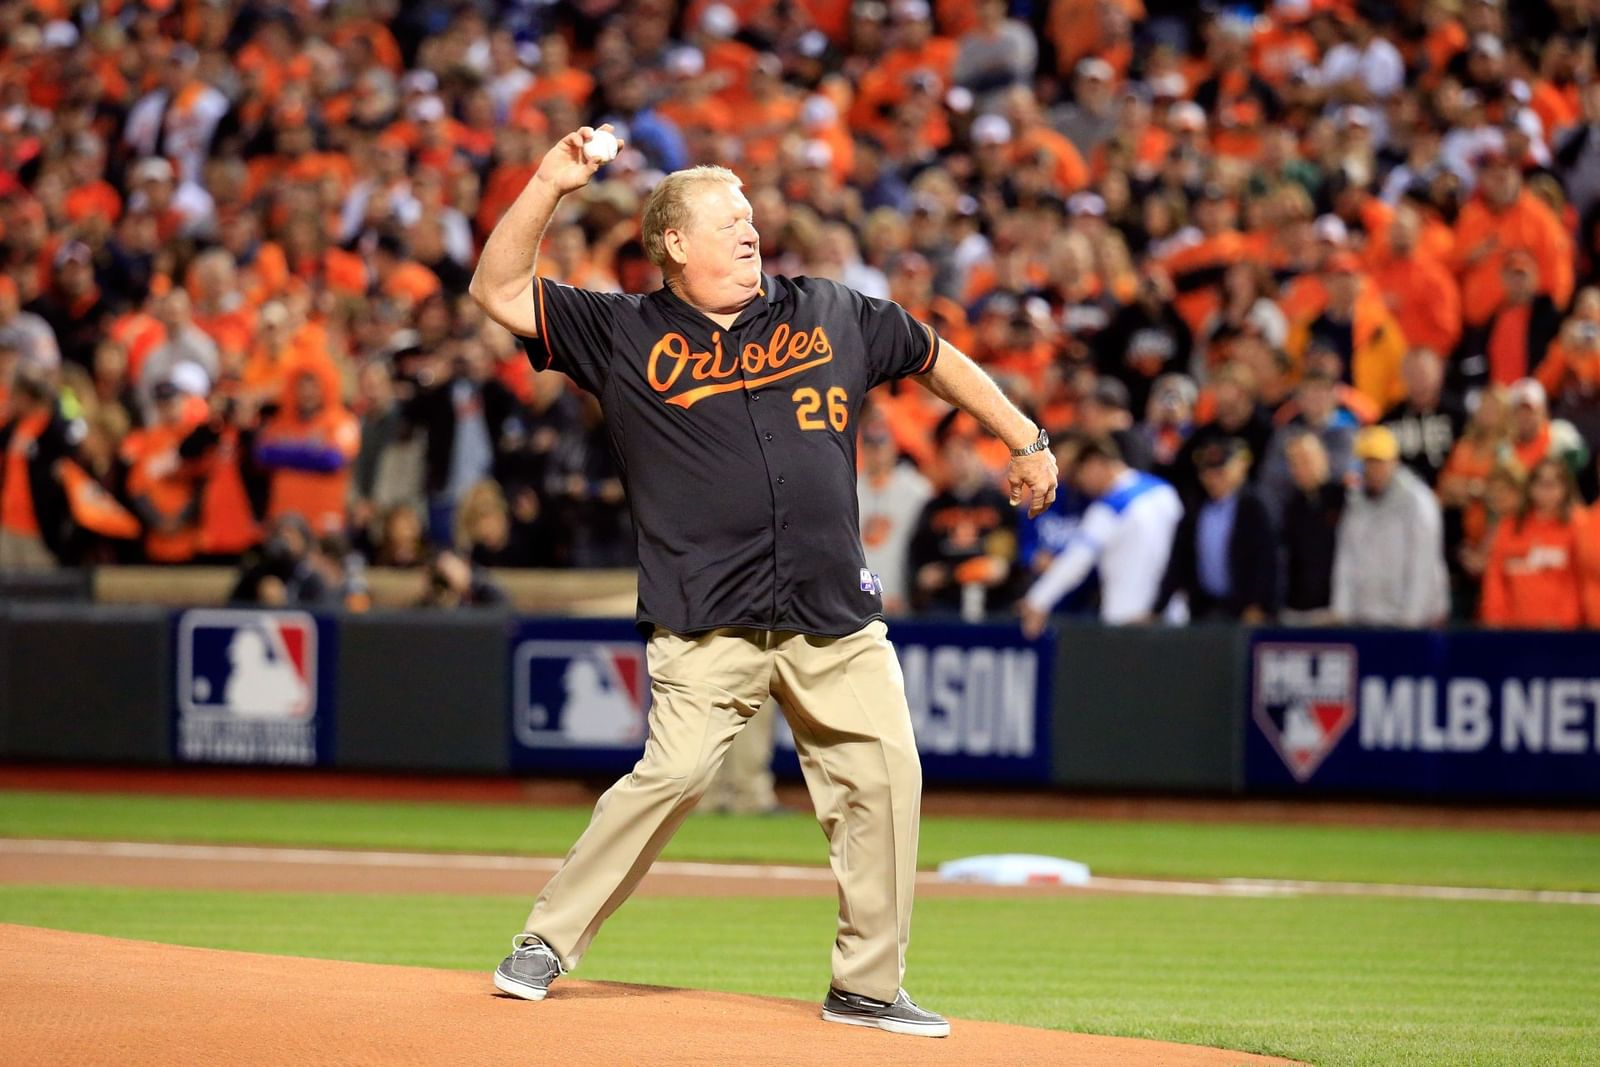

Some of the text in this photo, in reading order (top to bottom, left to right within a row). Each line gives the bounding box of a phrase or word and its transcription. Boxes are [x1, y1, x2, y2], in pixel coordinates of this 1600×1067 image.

[647, 323, 833, 392] Orioles
[792, 387, 848, 432] 26
[1259, 650, 1350, 694] MLB
[1360, 675, 1493, 752] MLB
